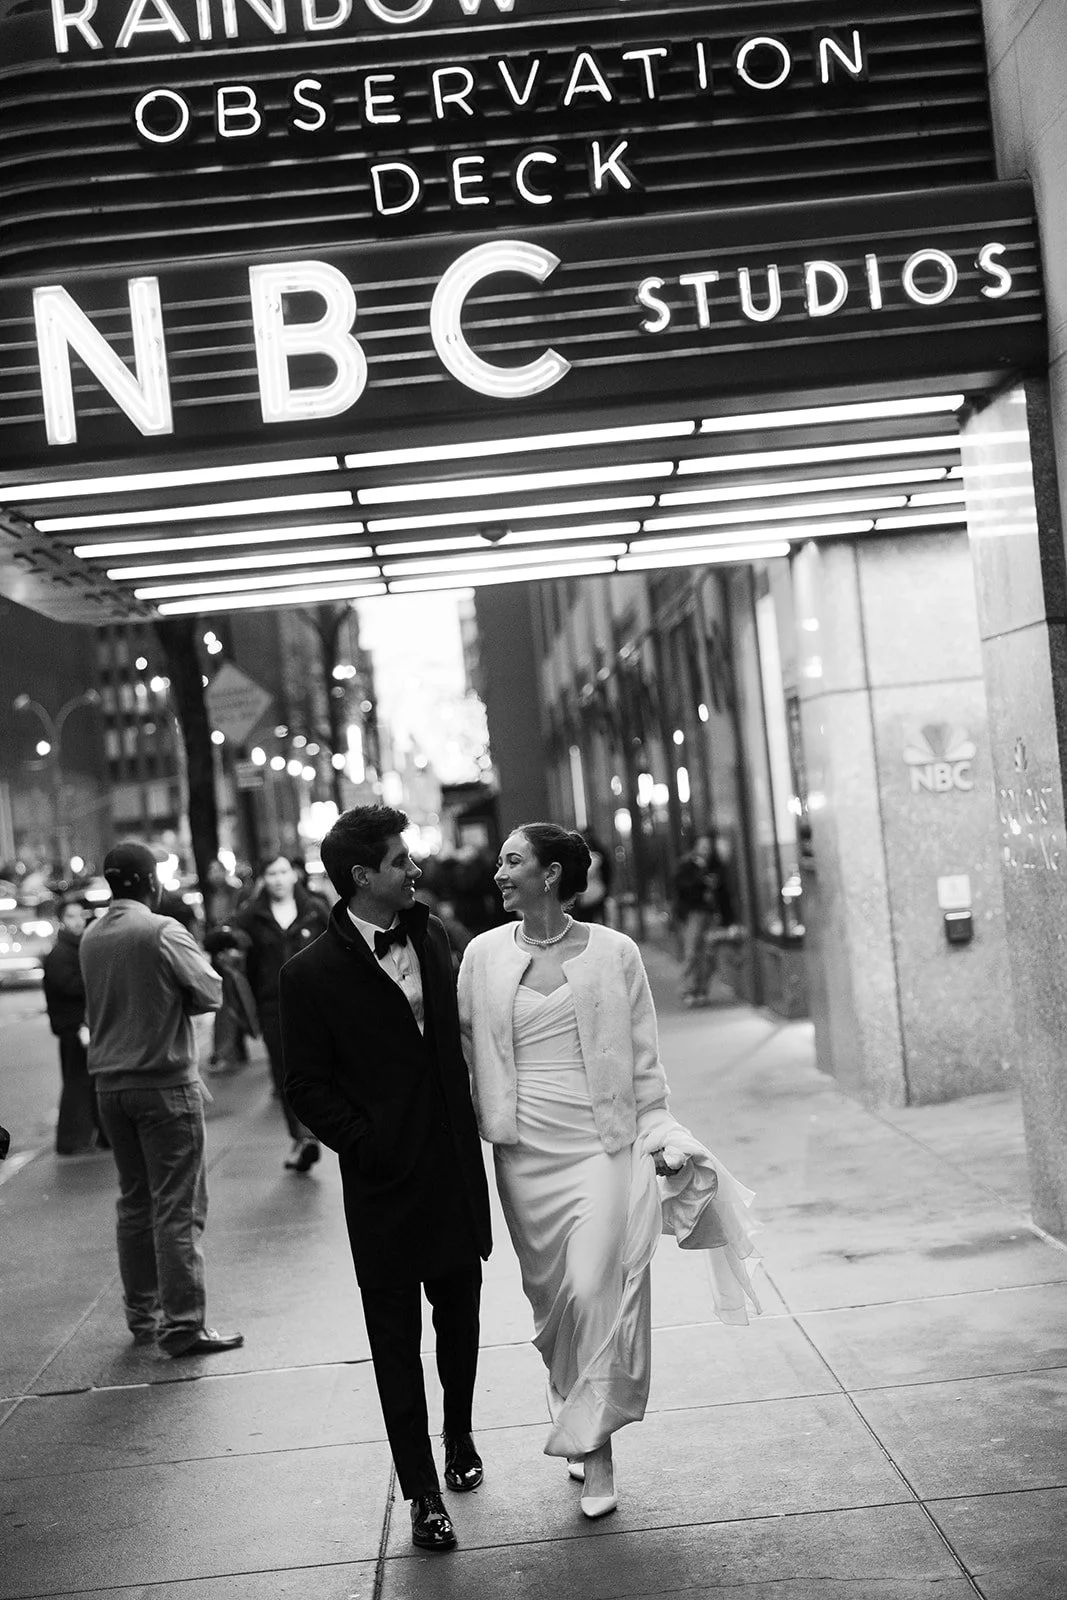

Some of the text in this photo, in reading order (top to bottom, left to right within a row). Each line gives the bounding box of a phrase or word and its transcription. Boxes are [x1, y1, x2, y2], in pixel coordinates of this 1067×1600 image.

[54, 0, 516, 53] RAIN
[134, 29, 864, 143] OBSERVATION
[370, 140, 632, 215] DECK
[32, 240, 1013, 445] NBC STUDIOS
[909, 760, 975, 793] NBC
